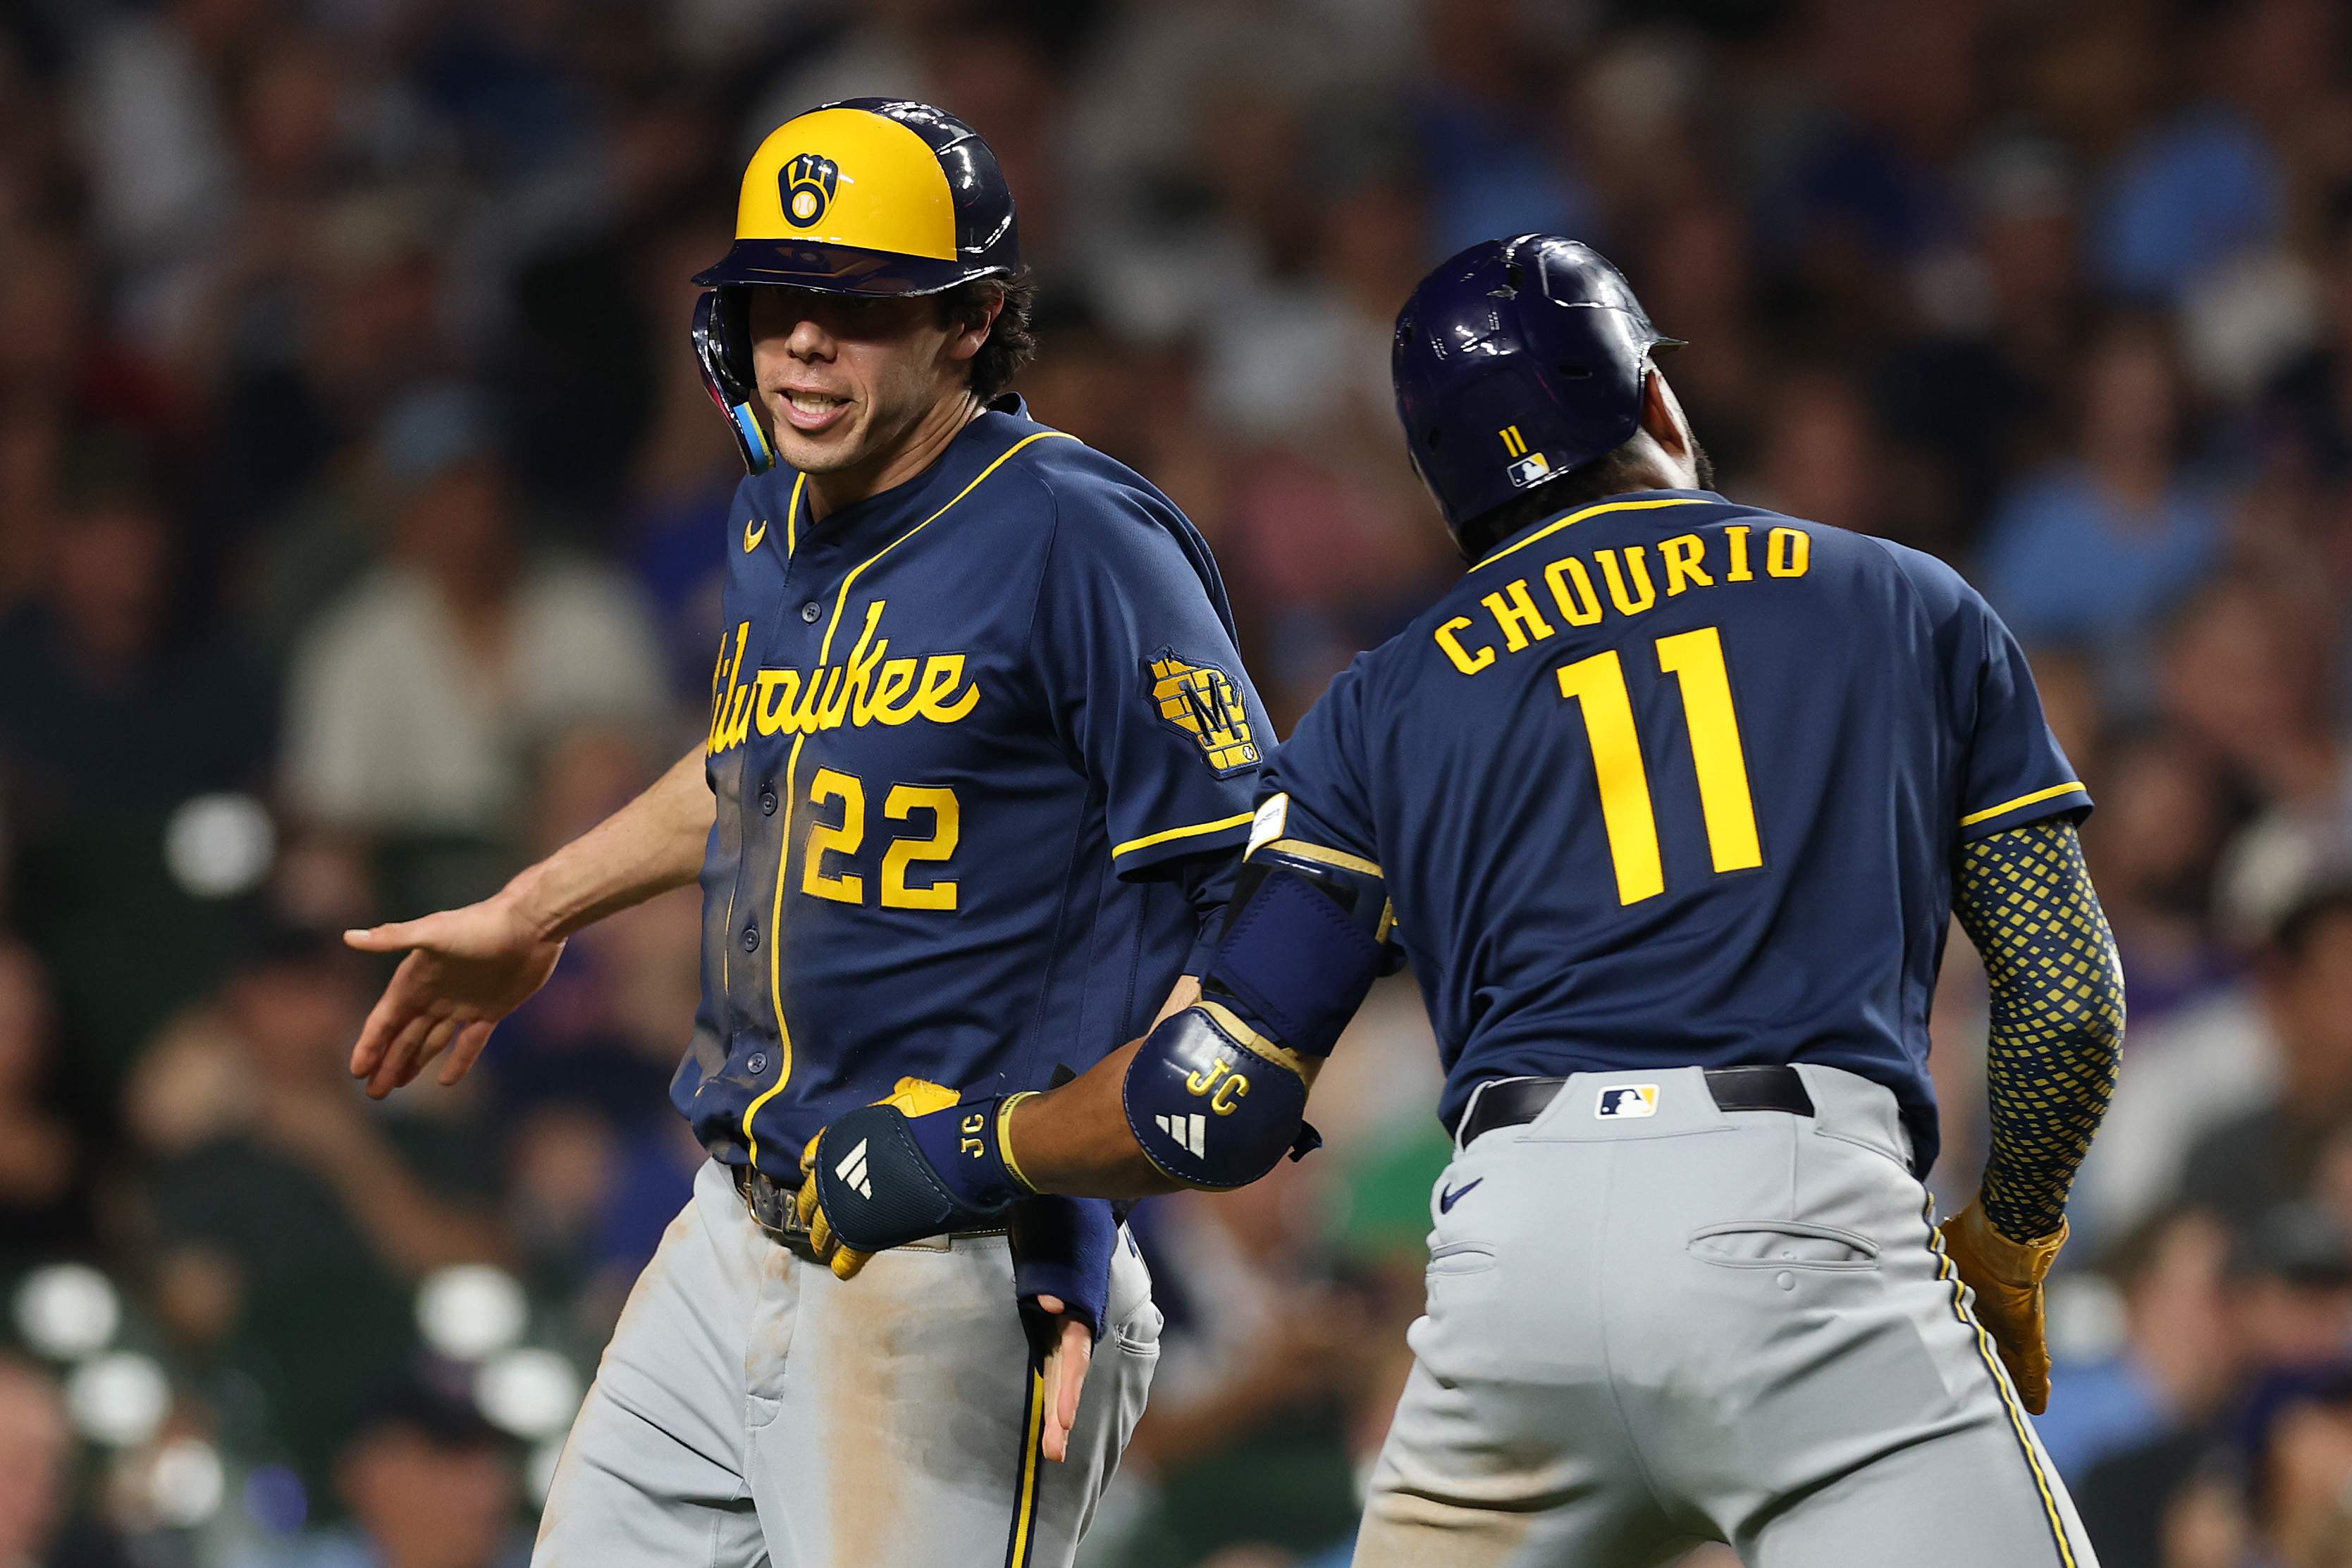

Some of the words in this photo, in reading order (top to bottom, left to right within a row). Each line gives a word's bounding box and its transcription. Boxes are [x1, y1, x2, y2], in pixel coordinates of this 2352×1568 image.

[1498, 425, 1528, 457] 11
[1434, 525, 1812, 676] CHOURIO
[707, 600, 981, 758] ilwaukee
[1178, 672, 1246, 746] M
[1556, 626, 1763, 907] 11
[801, 766, 961, 910] 22
[960, 1113, 985, 1159] JC
[1186, 1057, 1250, 1116] JC
